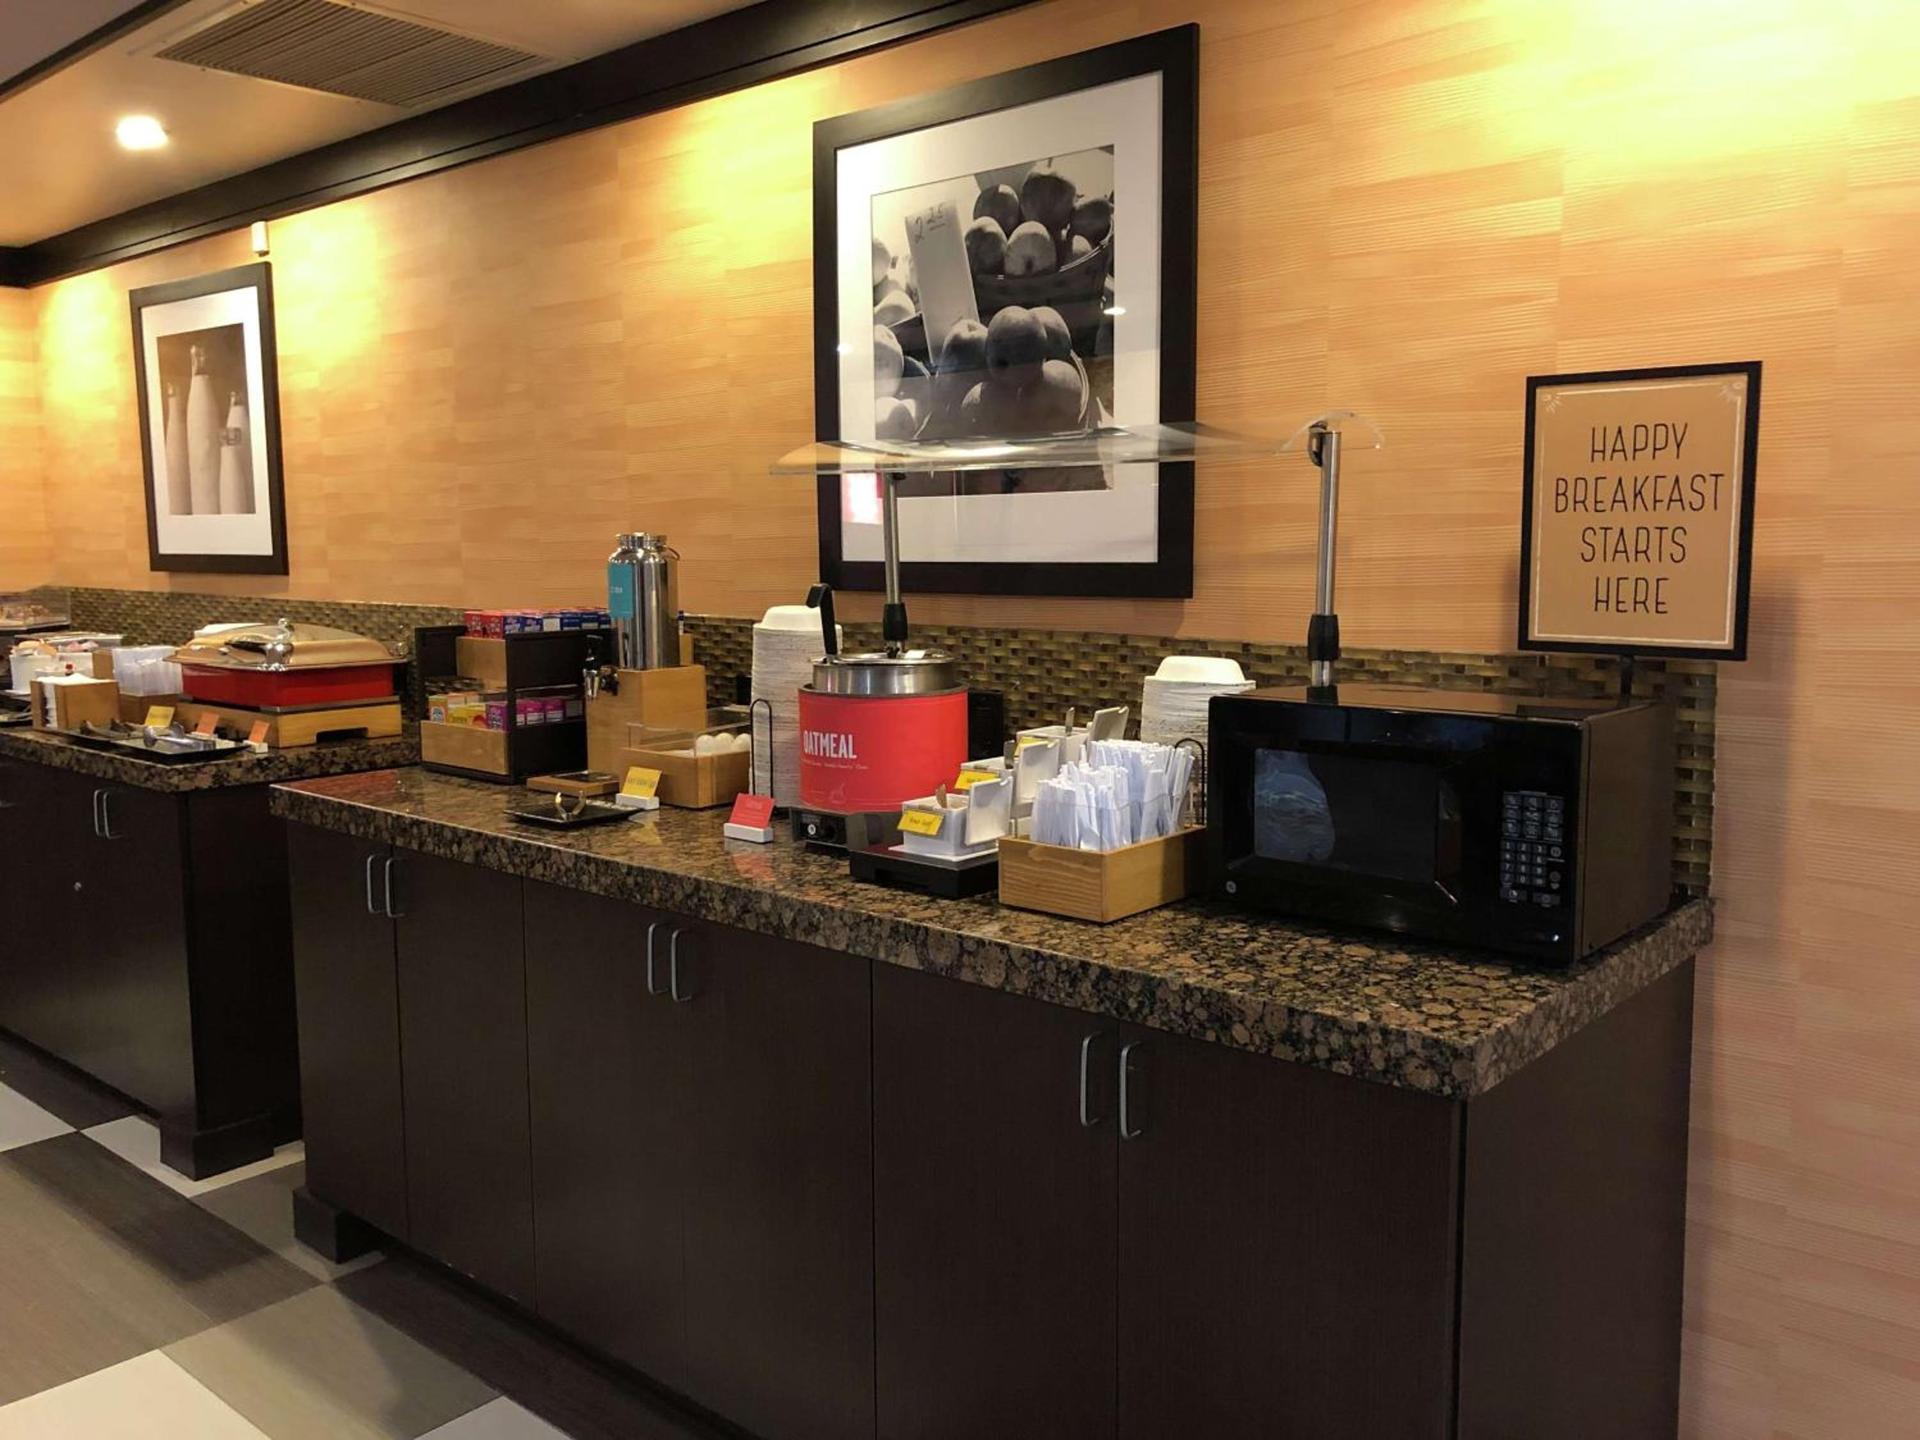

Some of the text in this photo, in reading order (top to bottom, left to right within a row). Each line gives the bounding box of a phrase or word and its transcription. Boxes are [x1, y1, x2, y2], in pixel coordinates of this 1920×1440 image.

[1591, 422, 1688, 462] HAPPY
[1554, 473, 1724, 513] BREAKFAST
[1580, 526, 1688, 563] STARTS
[1594, 576, 1669, 614] HERE
[803, 730, 857, 759] OATMEAL
